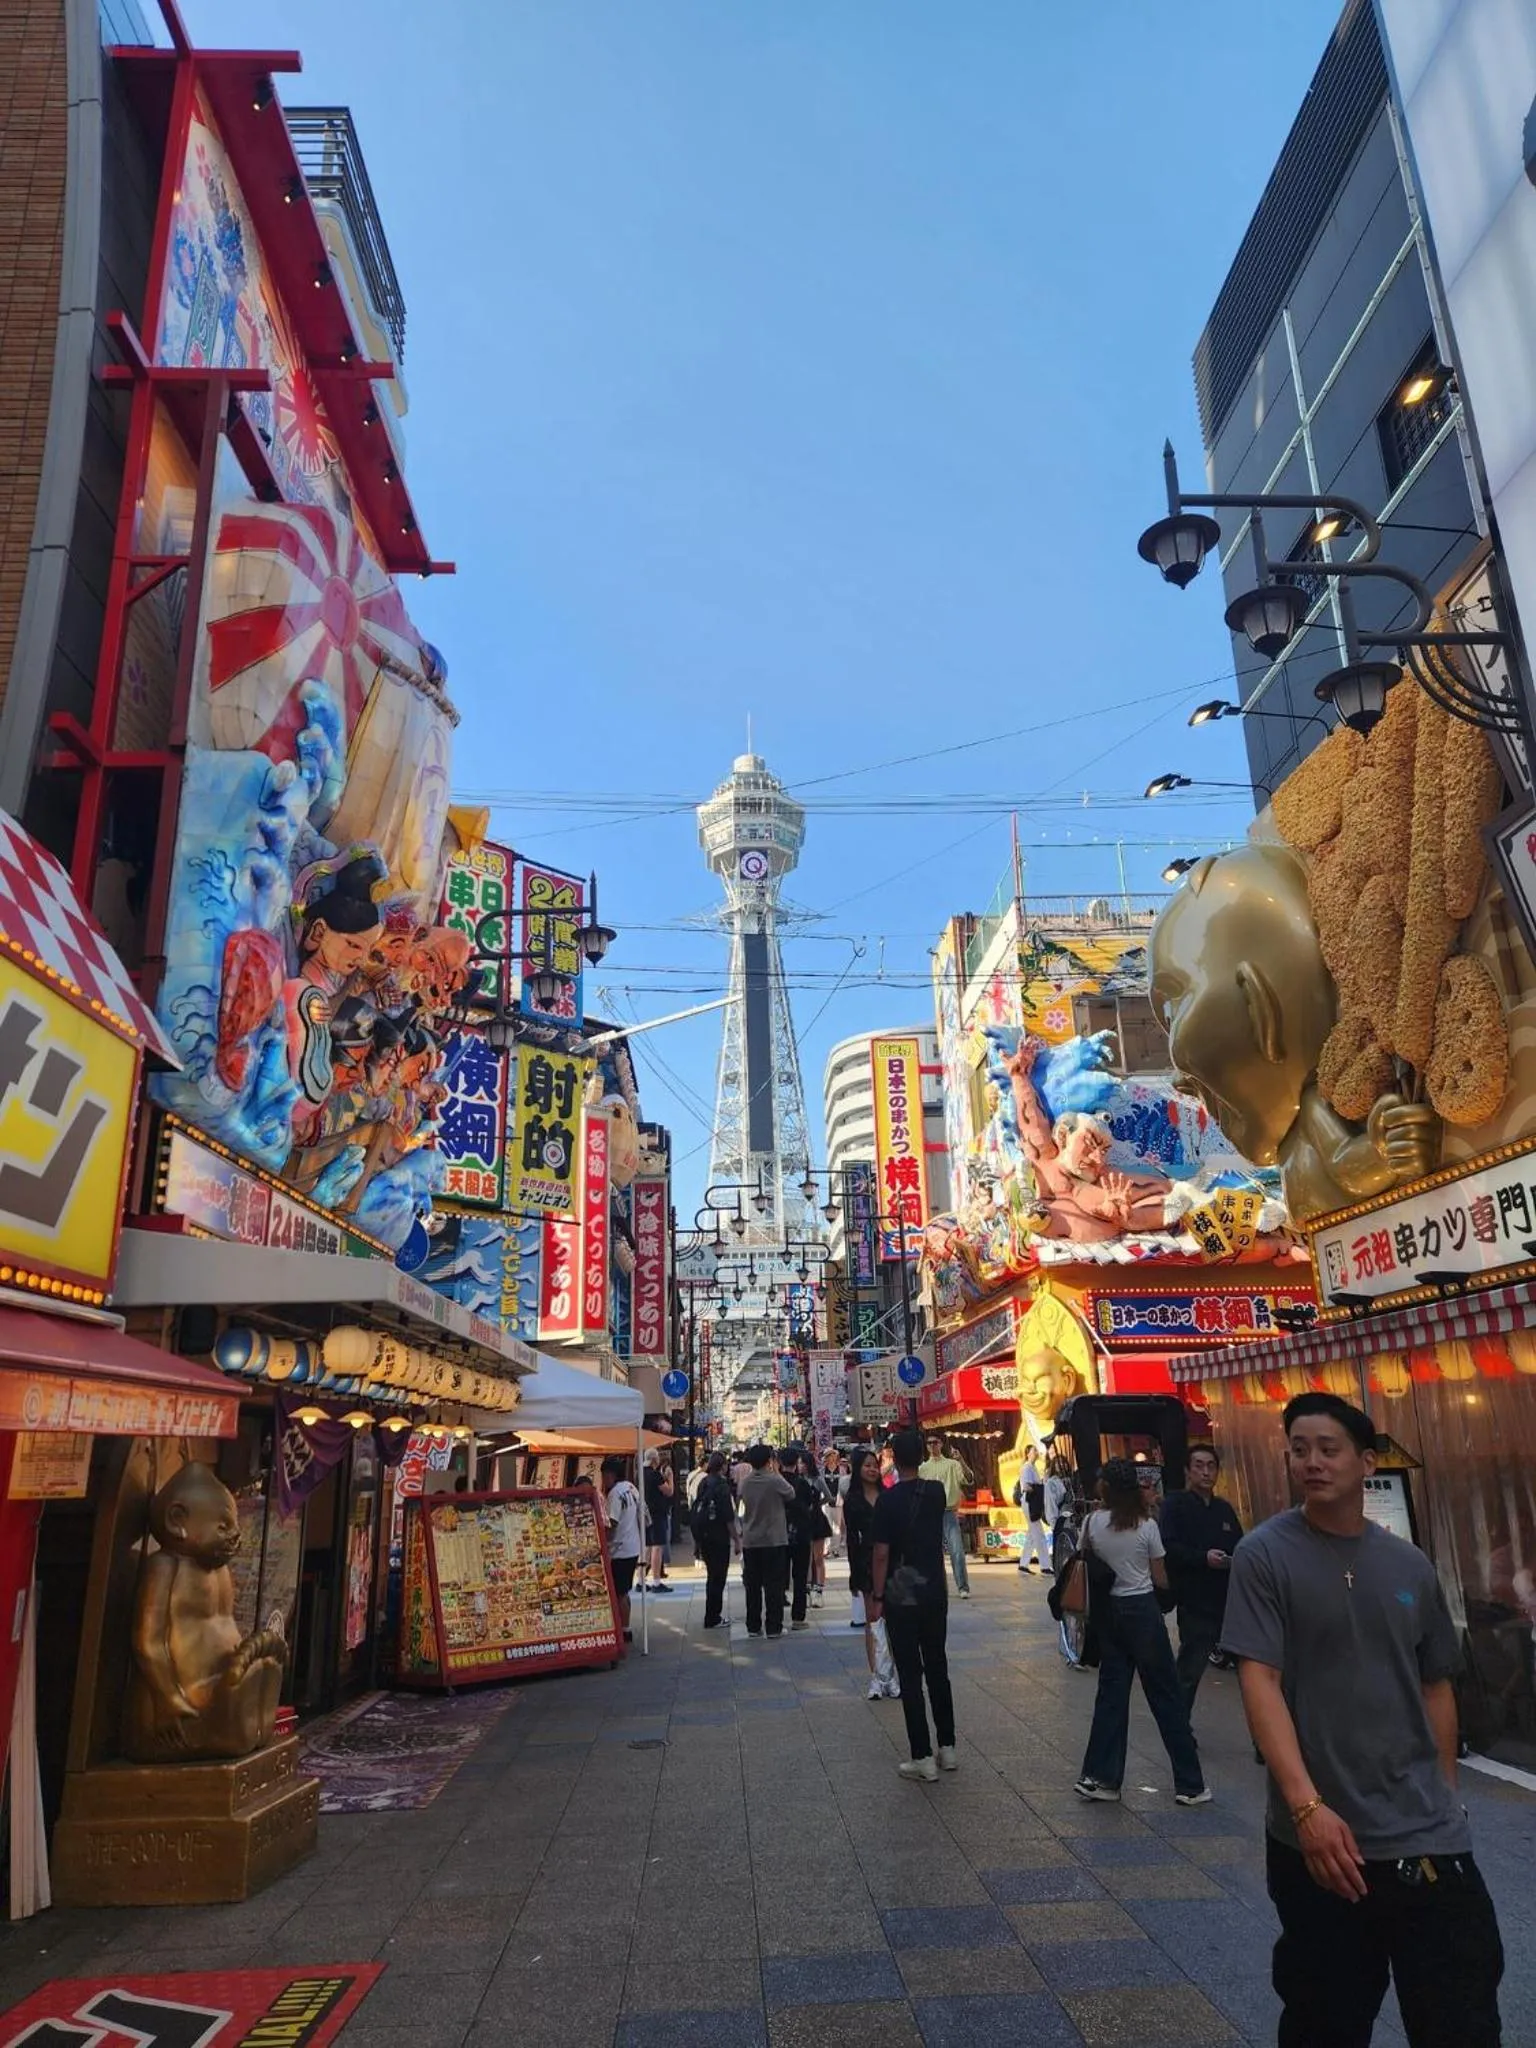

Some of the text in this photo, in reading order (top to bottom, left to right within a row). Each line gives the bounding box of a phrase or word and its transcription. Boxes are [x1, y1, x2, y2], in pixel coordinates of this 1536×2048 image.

[524, 1055, 577, 1180] 射的
[888, 1058, 910, 1154] 日本一の串かつ
[444, 1168, 497, 1200] 天閣店
[1351, 1181, 1536, 1280] 元祖串カツ専門
[1113, 1306, 1193, 1326] 日本一の串かつ
[1193, 1298, 1254, 1331] 横綱
